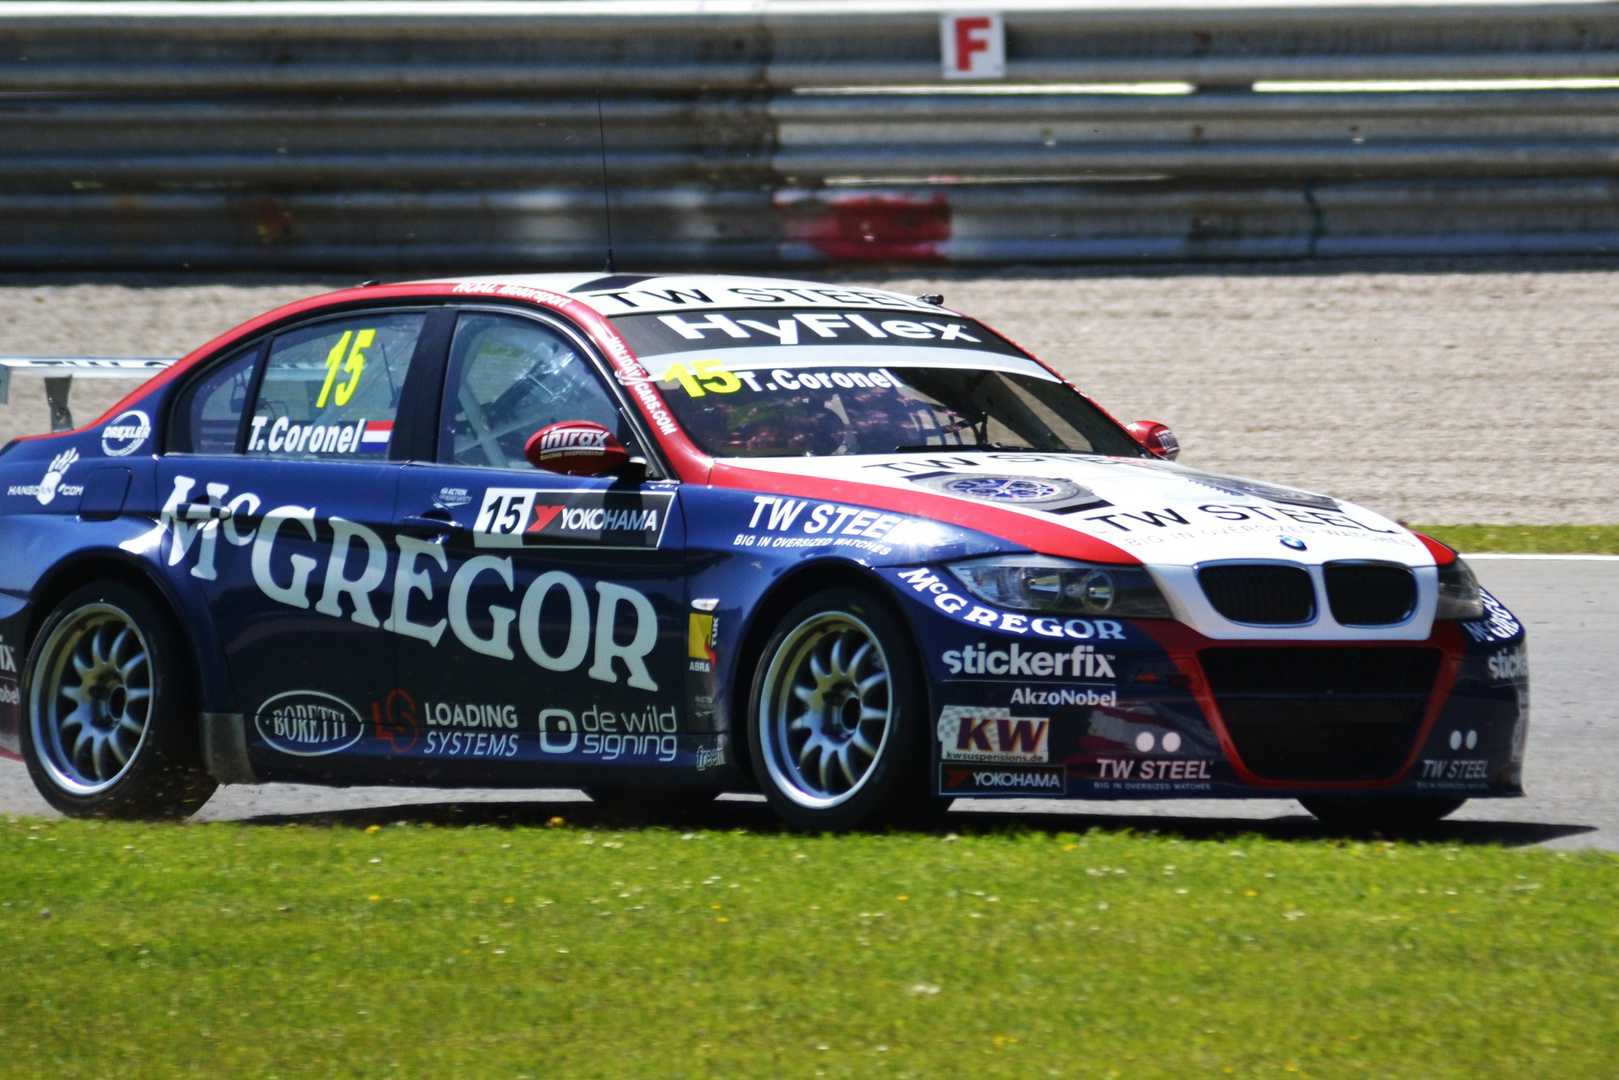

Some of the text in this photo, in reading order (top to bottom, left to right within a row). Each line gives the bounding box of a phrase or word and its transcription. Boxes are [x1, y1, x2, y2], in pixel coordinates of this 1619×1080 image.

[955, 17, 991, 71] F
[589, 287, 944, 312] TW STEEL
[657, 313, 982, 345] HyFlex
[316, 329, 376, 408] 15
[663, 359, 742, 398] 15
[484, 496, 526, 535] 15
[560, 506, 657, 531] YOKOHAMA
[748, 495, 809, 532] TW
[1082, 504, 1402, 534] TW STEEL
[733, 534, 892, 556] BIG IN OVERSIZED WATCHES
[158, 475, 659, 692] McGREGOR
[897, 567, 1126, 641] McGREGOR
[1010, 688, 1117, 707] AkzoNobel
[272, 705, 347, 743] BORETTI
[424, 703, 518, 728] LOADING
[581, 704, 677, 733] de wild
[423, 731, 518, 757] SYSTEMS
[582, 733, 677, 762] signing
[956, 717, 1048, 754] KW
[972, 772, 1061, 788] YOKOHAMA
[1096, 758, 1212, 779] TW STEEL
[1423, 759, 1448, 779] TW
[1447, 760, 1489, 779] STEEL
